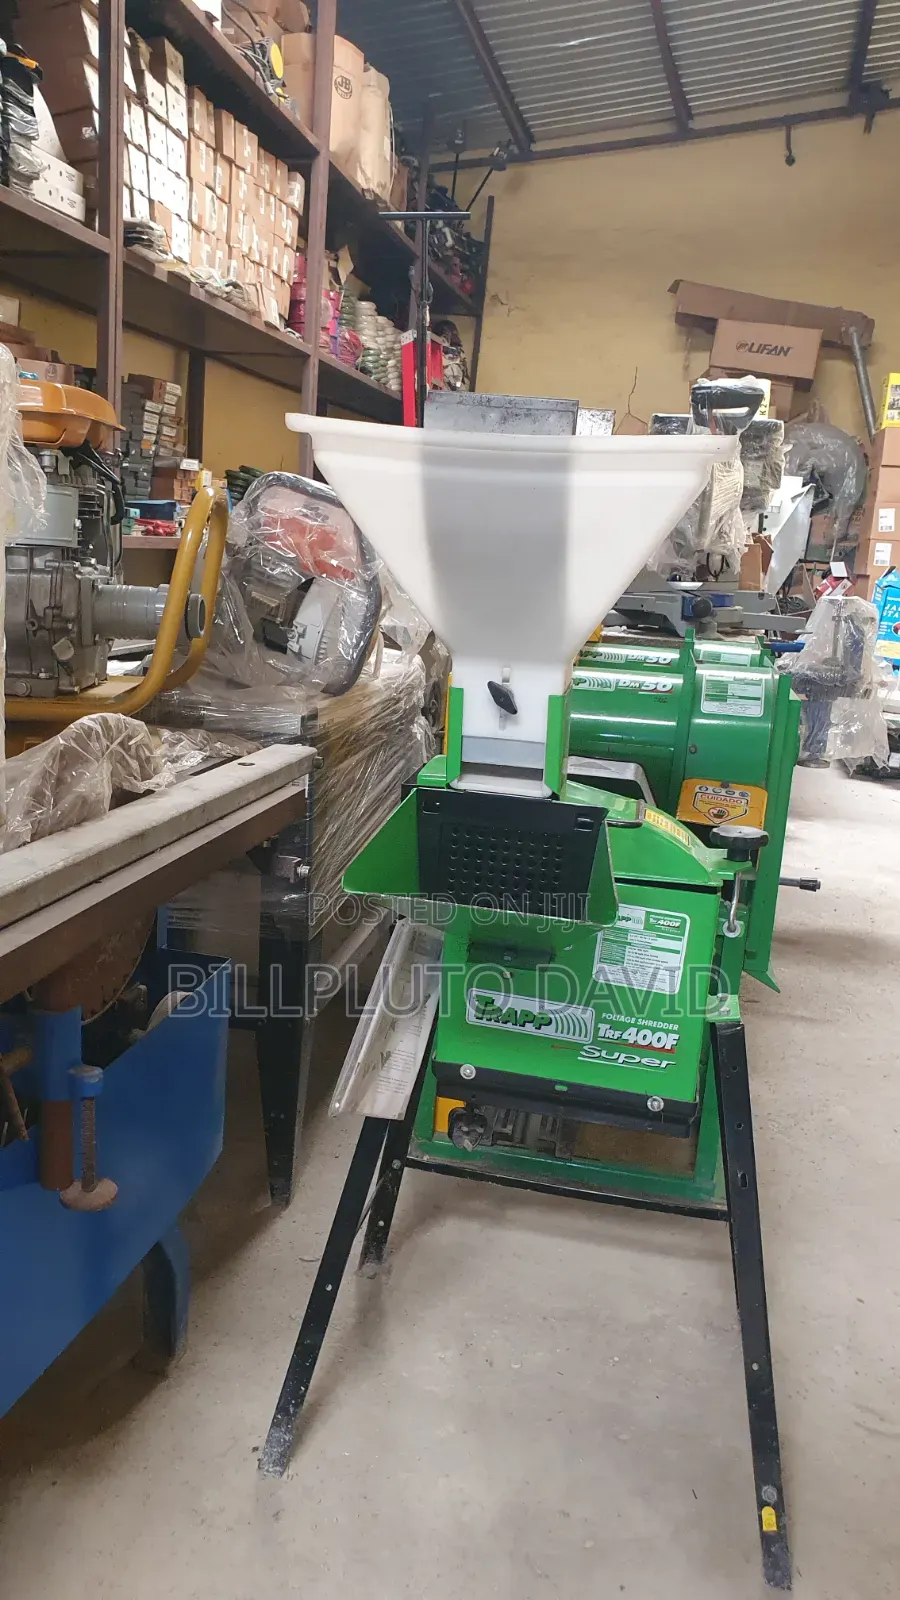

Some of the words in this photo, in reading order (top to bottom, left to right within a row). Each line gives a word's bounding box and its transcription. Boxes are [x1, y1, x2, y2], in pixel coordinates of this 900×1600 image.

[748, 342, 791, 357] LIFAN
[700, 793, 743, 804] CUIDADO
[474, 995, 552, 1030] TRAPP
[601, 1012, 636, 1024] FOLIAGE
[636, 1018, 679, 1031] SHREDDER
[580, 1045, 676, 1069] Super
